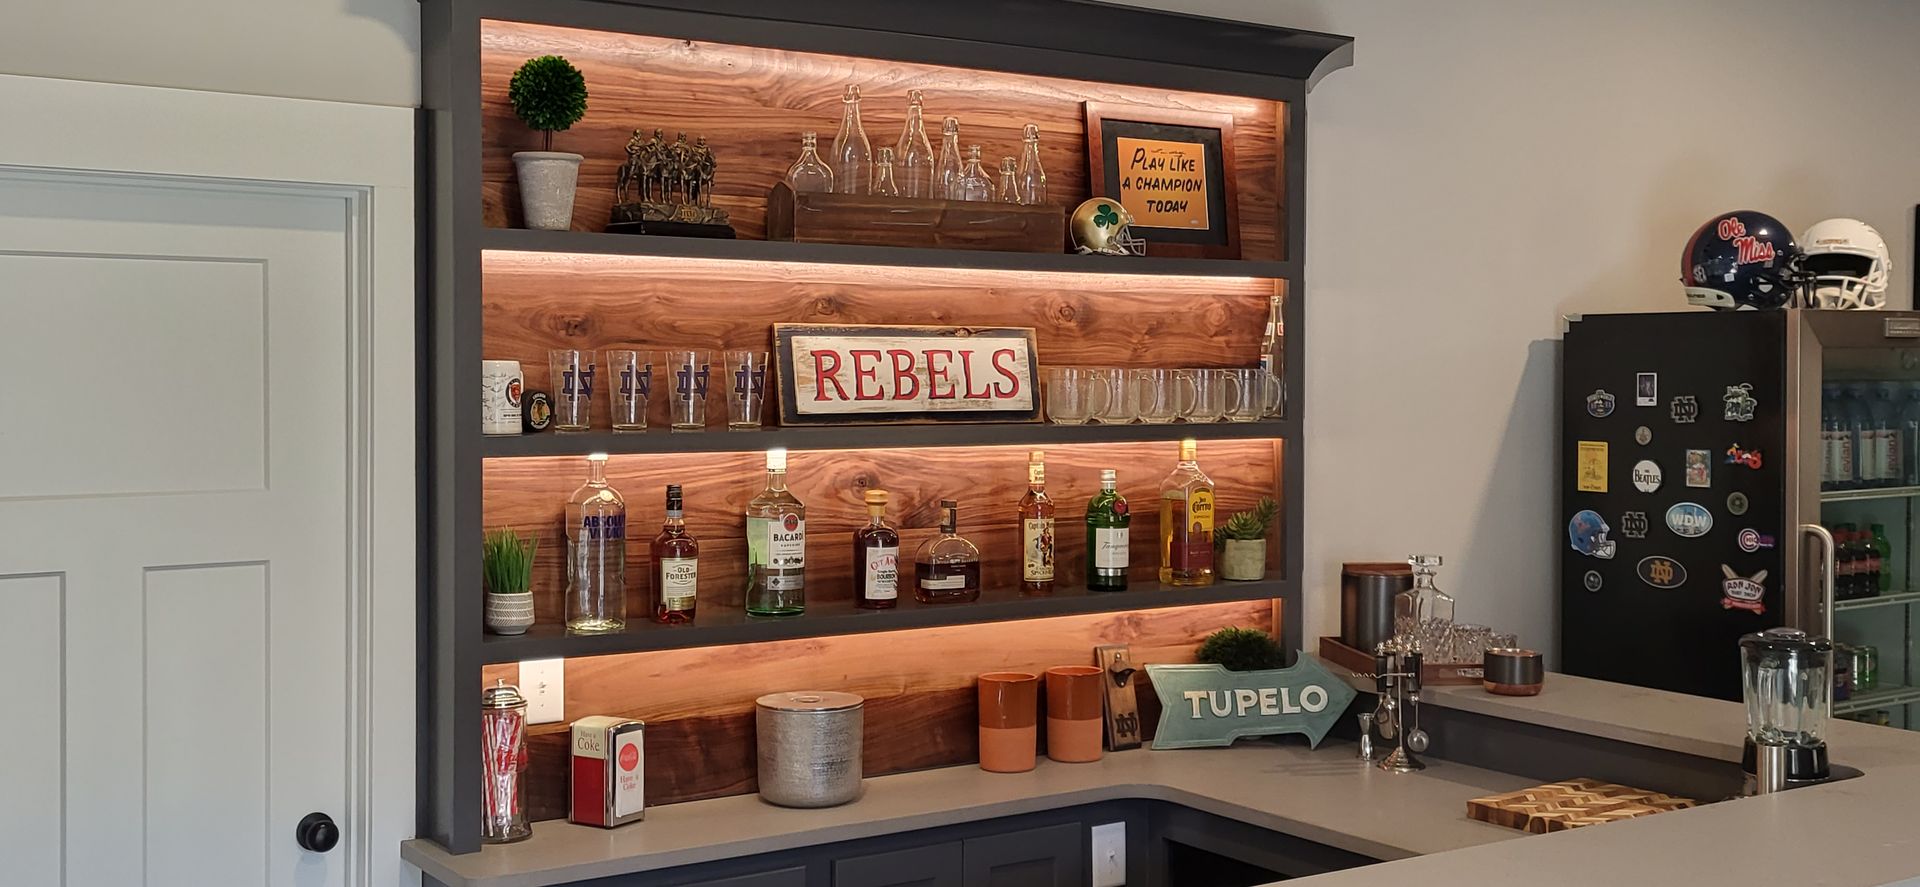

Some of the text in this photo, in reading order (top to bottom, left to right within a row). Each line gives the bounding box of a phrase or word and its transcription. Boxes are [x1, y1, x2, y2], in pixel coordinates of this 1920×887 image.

[1122, 176, 1203, 192] A CHAMPION
[1146, 200, 1189, 213] TODAY
[1719, 217, 1746, 240] Ole
[1733, 236, 1775, 265] Miss
[810, 349, 1020, 401] REBELS
[1634, 469, 1660, 485] BEATLES
[1671, 514, 1707, 527] WDW
[1183, 684, 1328, 719] TUPELO
[577, 737, 600, 751] Coke
